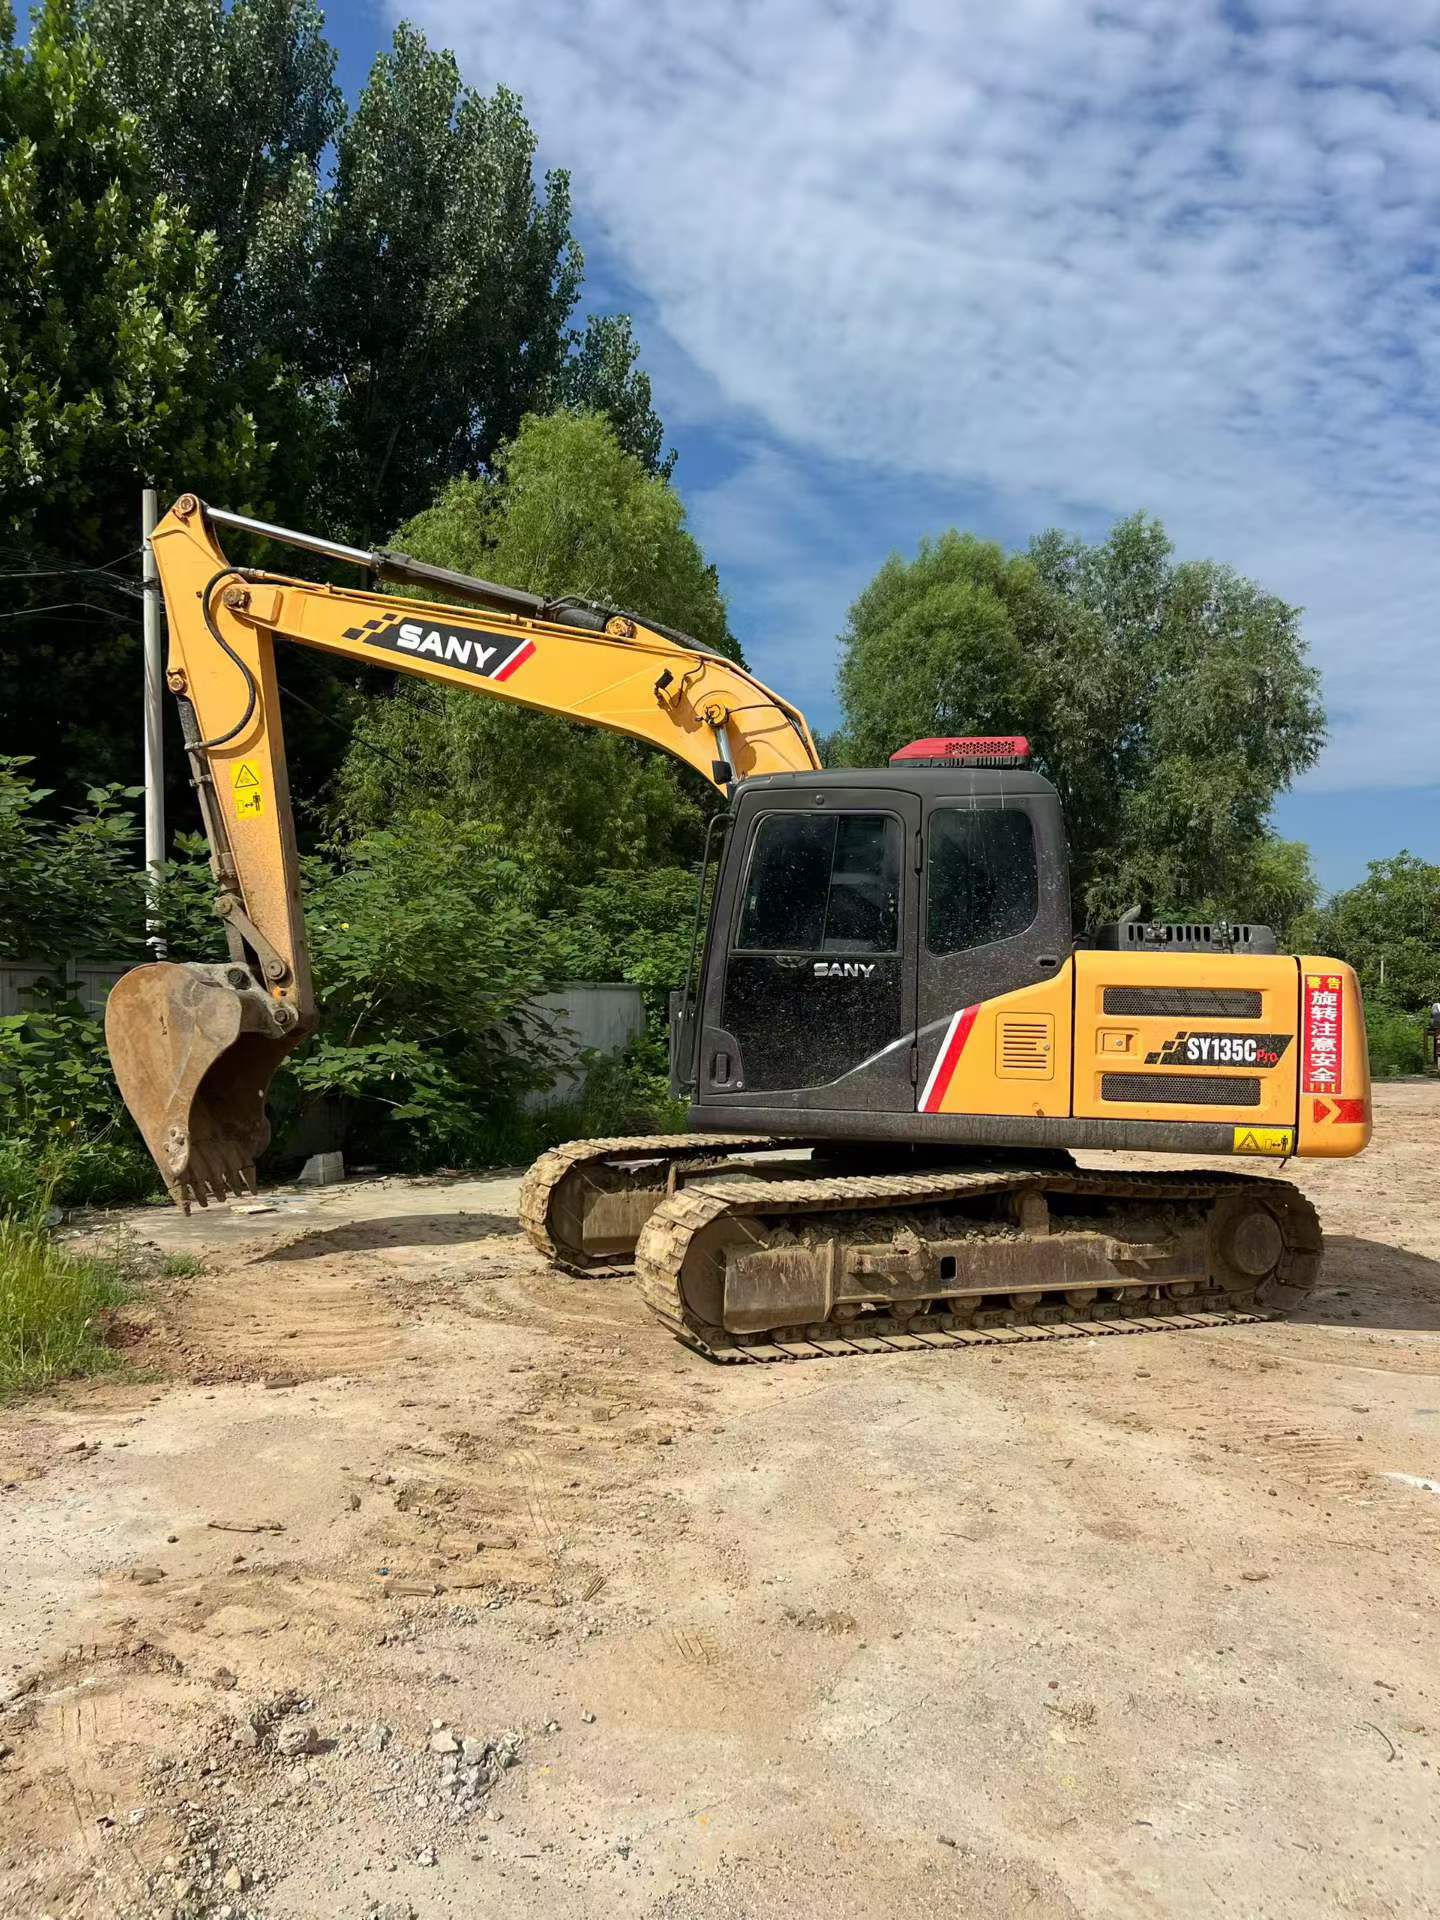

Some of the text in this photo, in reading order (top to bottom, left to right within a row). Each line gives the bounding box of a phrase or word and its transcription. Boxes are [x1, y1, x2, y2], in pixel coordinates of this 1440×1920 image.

[396, 623, 498, 669] SANY
[813, 962, 876, 978] SANY
[1306, 976, 1341, 990] 警告
[1186, 1037, 1279, 1064] SY135C Pro
[1309, 991, 1337, 1083] 旋转注意安全
